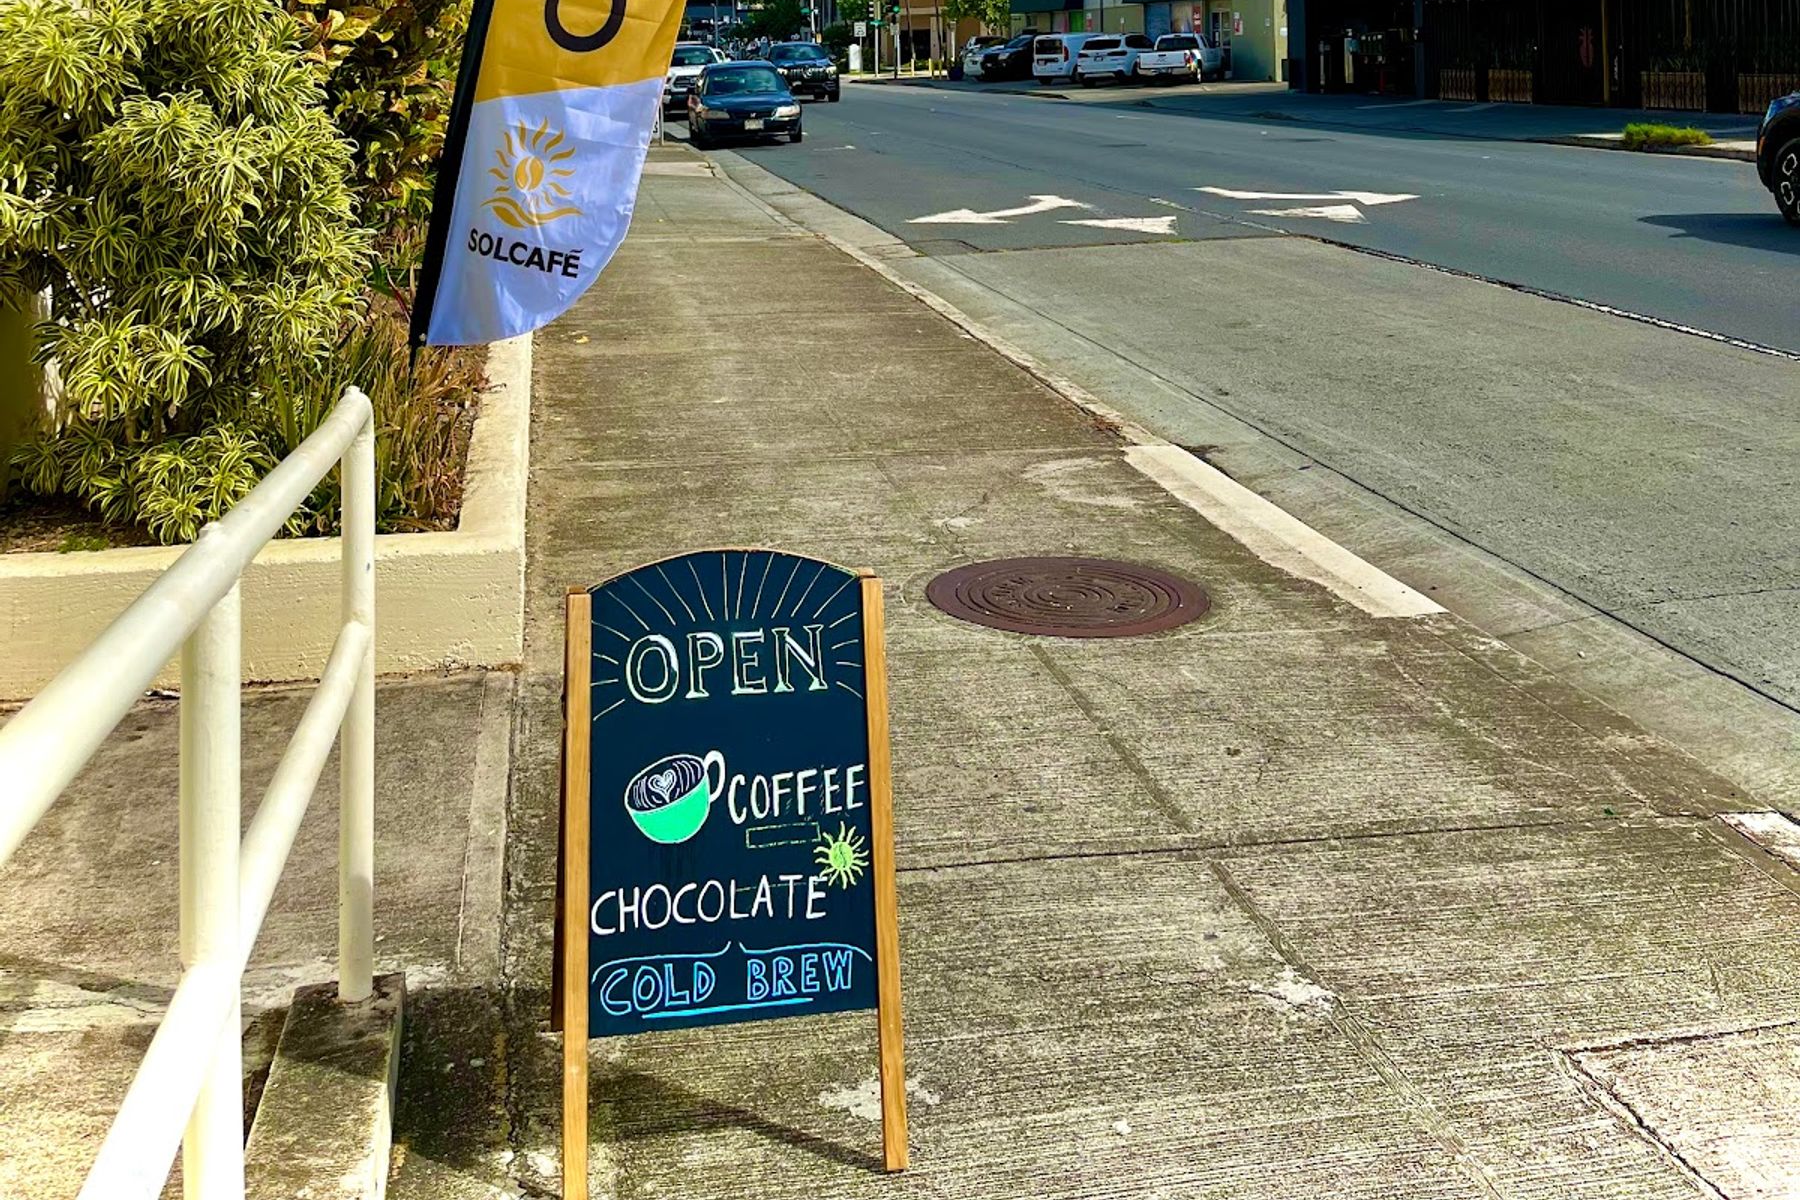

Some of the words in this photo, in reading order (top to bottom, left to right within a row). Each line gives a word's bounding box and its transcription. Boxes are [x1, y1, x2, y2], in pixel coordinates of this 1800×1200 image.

[468, 227, 584, 278] SOLCAFÉ
[625, 624, 828, 704] OPEN
[728, 764, 865, 825] COFFEE
[591, 875, 828, 936] CHOCOLATE
[600, 962, 717, 1016] COLD
[746, 950, 853, 1001] BREW
